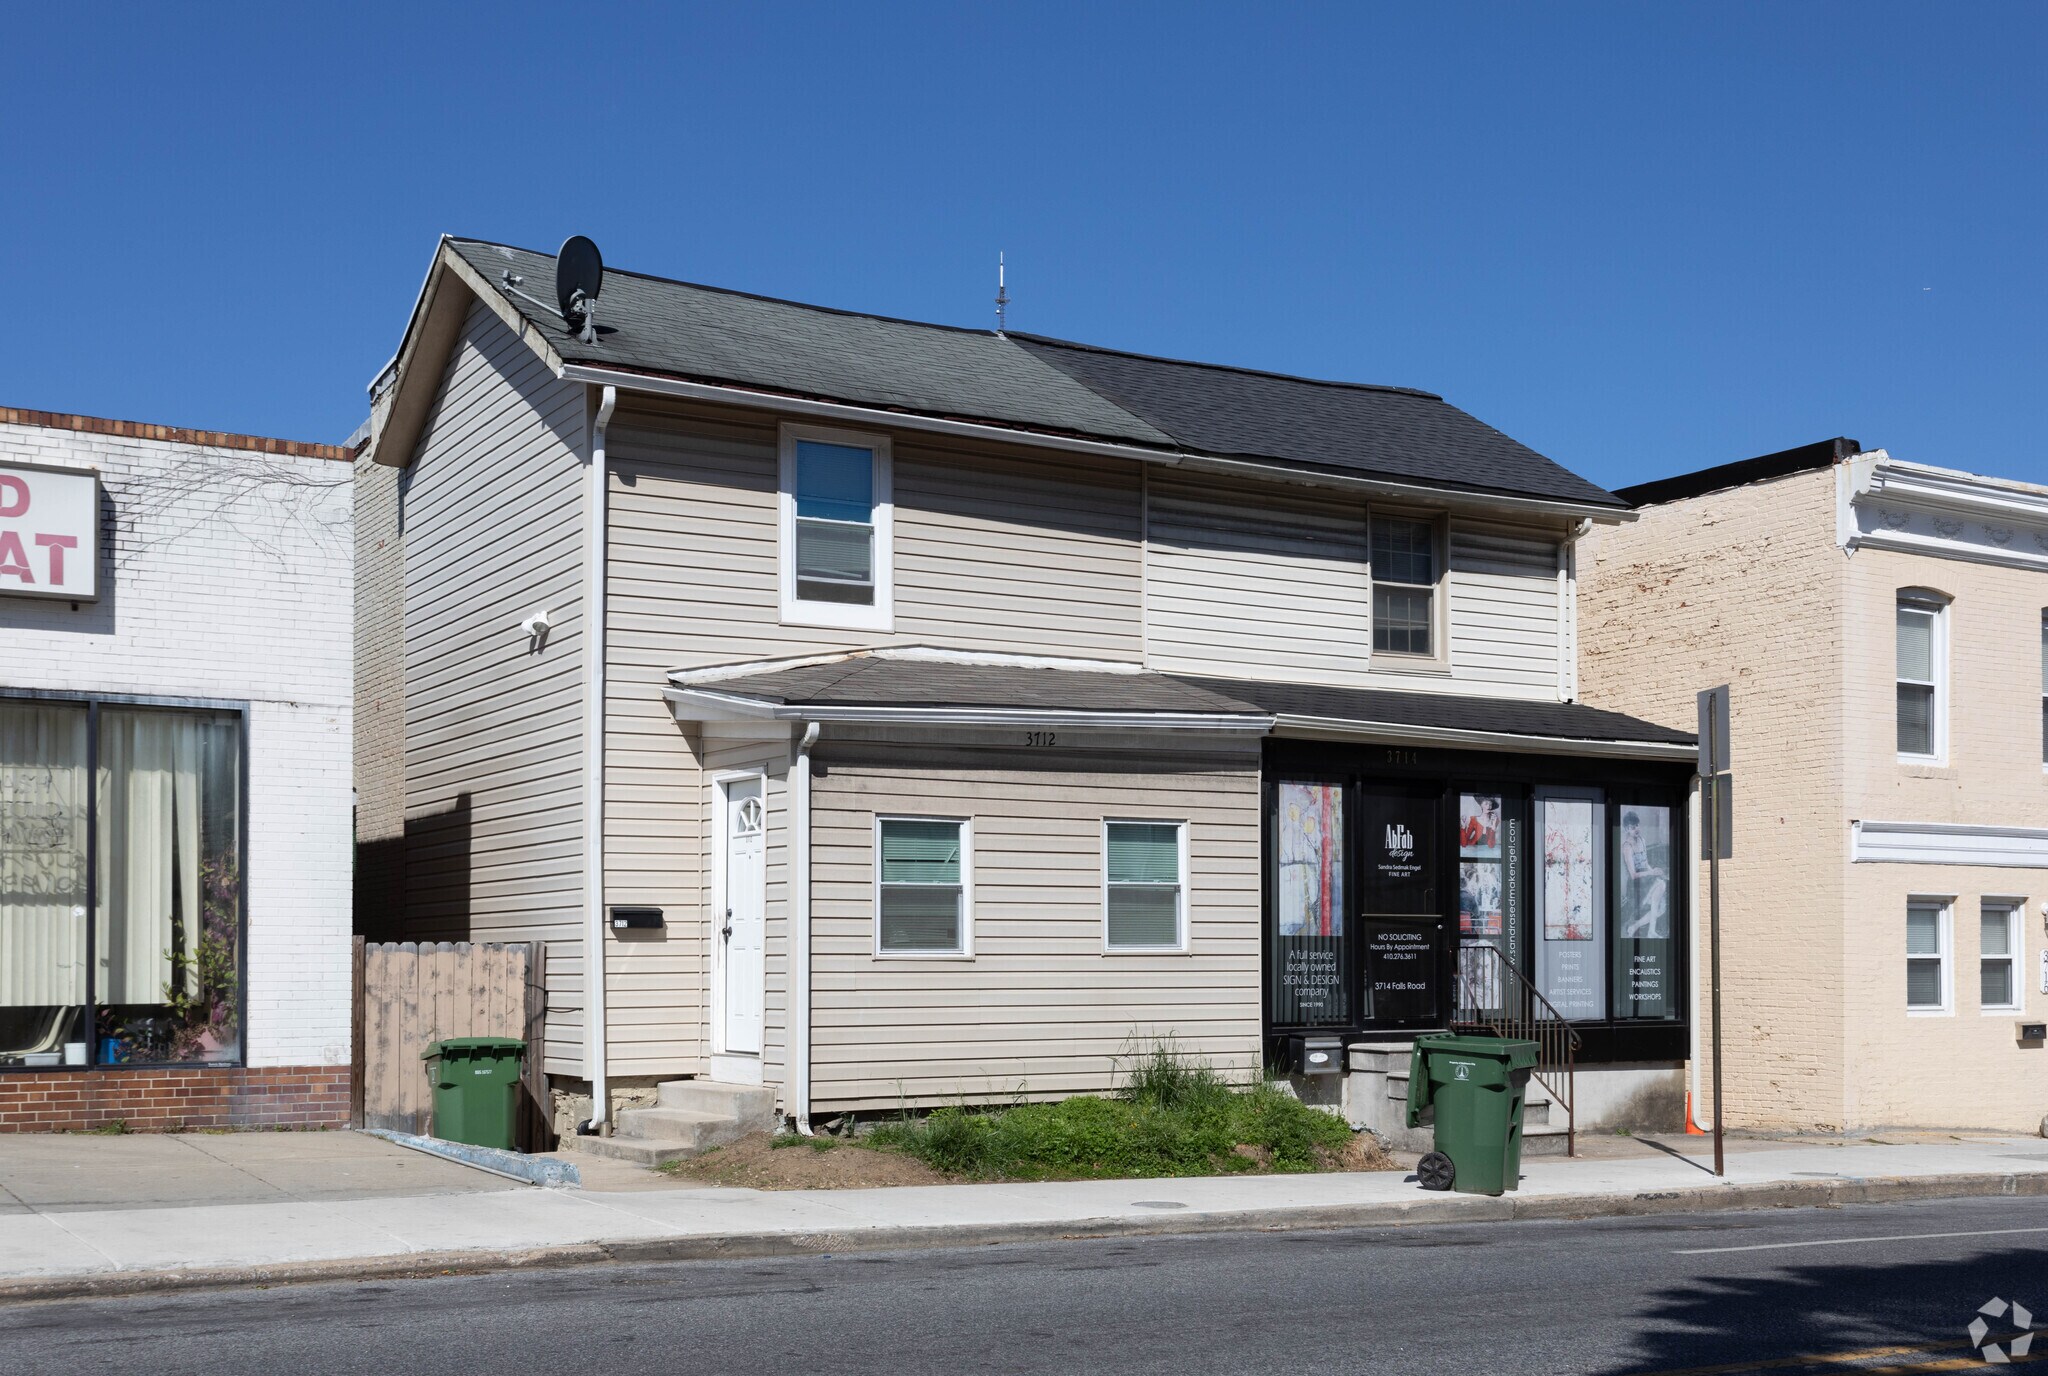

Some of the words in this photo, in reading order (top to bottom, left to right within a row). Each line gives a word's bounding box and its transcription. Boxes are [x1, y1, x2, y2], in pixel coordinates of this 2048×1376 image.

[1025, 731, 1056, 747] 3712
[1386, 750, 1417, 765] 3714
[1384, 823, 1413, 849] AbFab
[1388, 848, 1415, 862] design
[1409, 864, 1422, 872] Engel
[1389, 933, 1422, 941] SOLICITING
[1386, 943, 1394, 951] By
[1394, 943, 1430, 951] Appointment
[1288, 950, 1296, 960] A
[1296, 950, 1308, 960] full
[1309, 950, 1334, 960] service
[1634, 955, 1646, 963] FINE
[1646, 955, 1656, 963] ART
[1286, 962, 1309, 974] locally
[1310, 962, 1336, 971] owned
[1629, 968, 1662, 976] ENCAUSTICS
[1283, 975, 1302, 985] SIGN
[1303, 975, 1310, 985] &
[1311, 975, 1340, 985] DESIGN
[1631, 980, 1659, 988] PAINTINGS
[1374, 982, 1391, 990] 3714
[1391, 982, 1406, 990] Falls
[1407, 982, 1426, 990] Road
[1294, 988, 1329, 999] company
[1549, 988, 1566, 996] ARTIST
[1567, 988, 1592, 996] SERVICES
[1628, 993, 1662, 1001] WORKSHOPS
[1569, 1000, 1594, 1008] PRINTING
